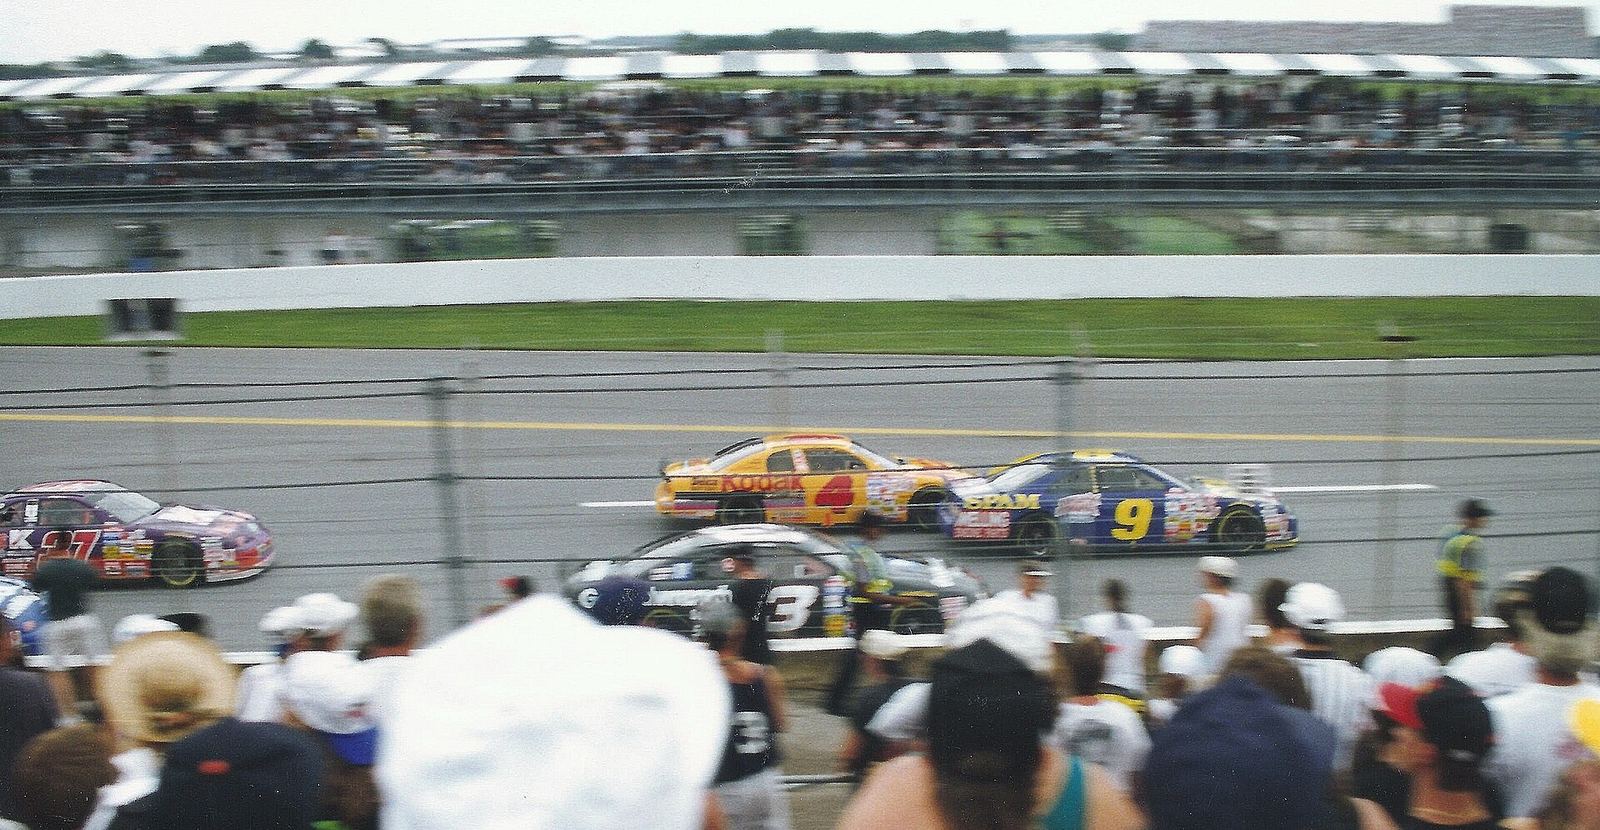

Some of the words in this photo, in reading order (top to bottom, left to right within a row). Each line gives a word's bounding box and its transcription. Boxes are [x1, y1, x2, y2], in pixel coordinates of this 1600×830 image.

[719, 474, 804, 492] Kodak
[815, 475, 853, 513] 4
[963, 493, 1042, 510] SPAM
[1110, 498, 1154, 541] 9
[766, 585, 820, 632] 3
[734, 711, 769, 754] 3
